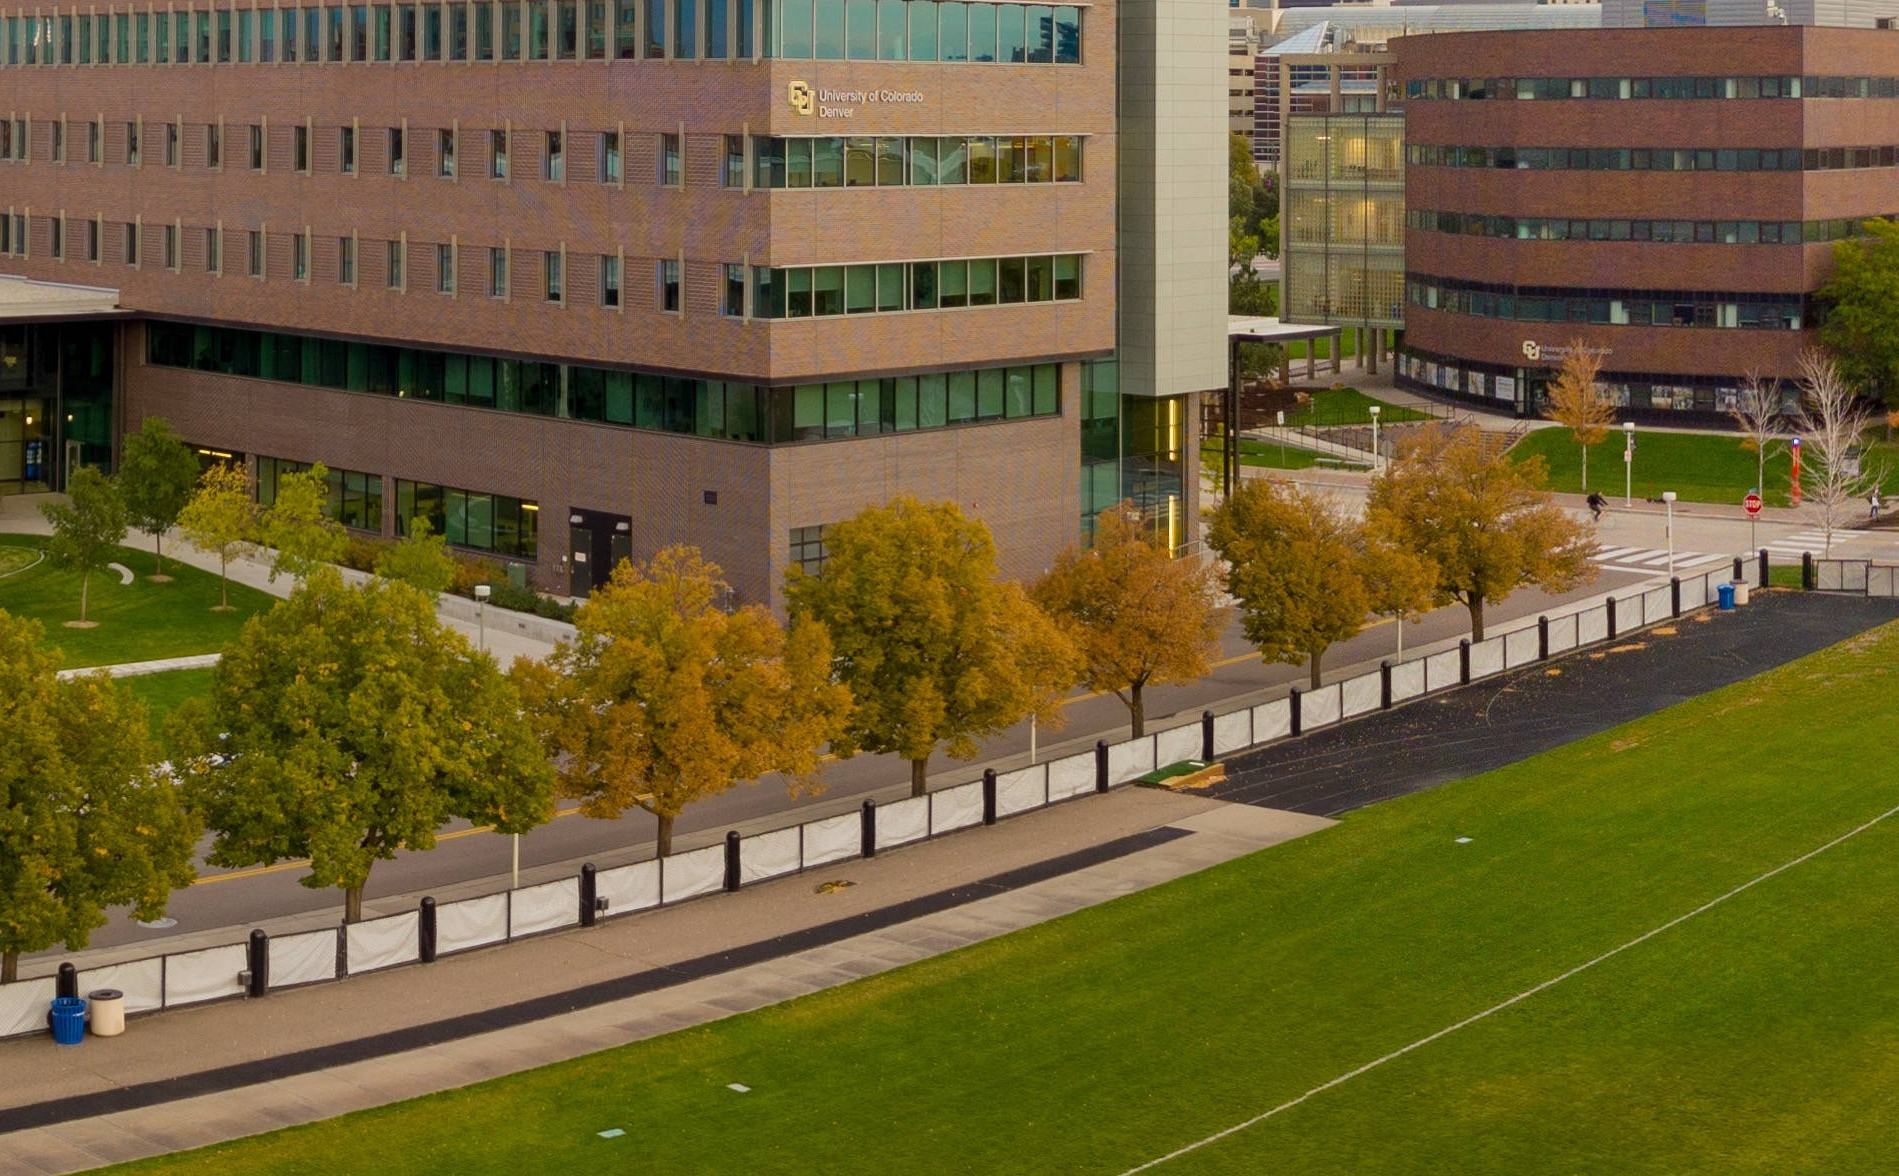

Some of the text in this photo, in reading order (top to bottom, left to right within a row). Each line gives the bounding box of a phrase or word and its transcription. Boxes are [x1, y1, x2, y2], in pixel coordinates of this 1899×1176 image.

[819, 90, 923, 104] University of Colorado
[819, 106, 853, 118] Denver
[1746, 500, 1761, 508] STOP
